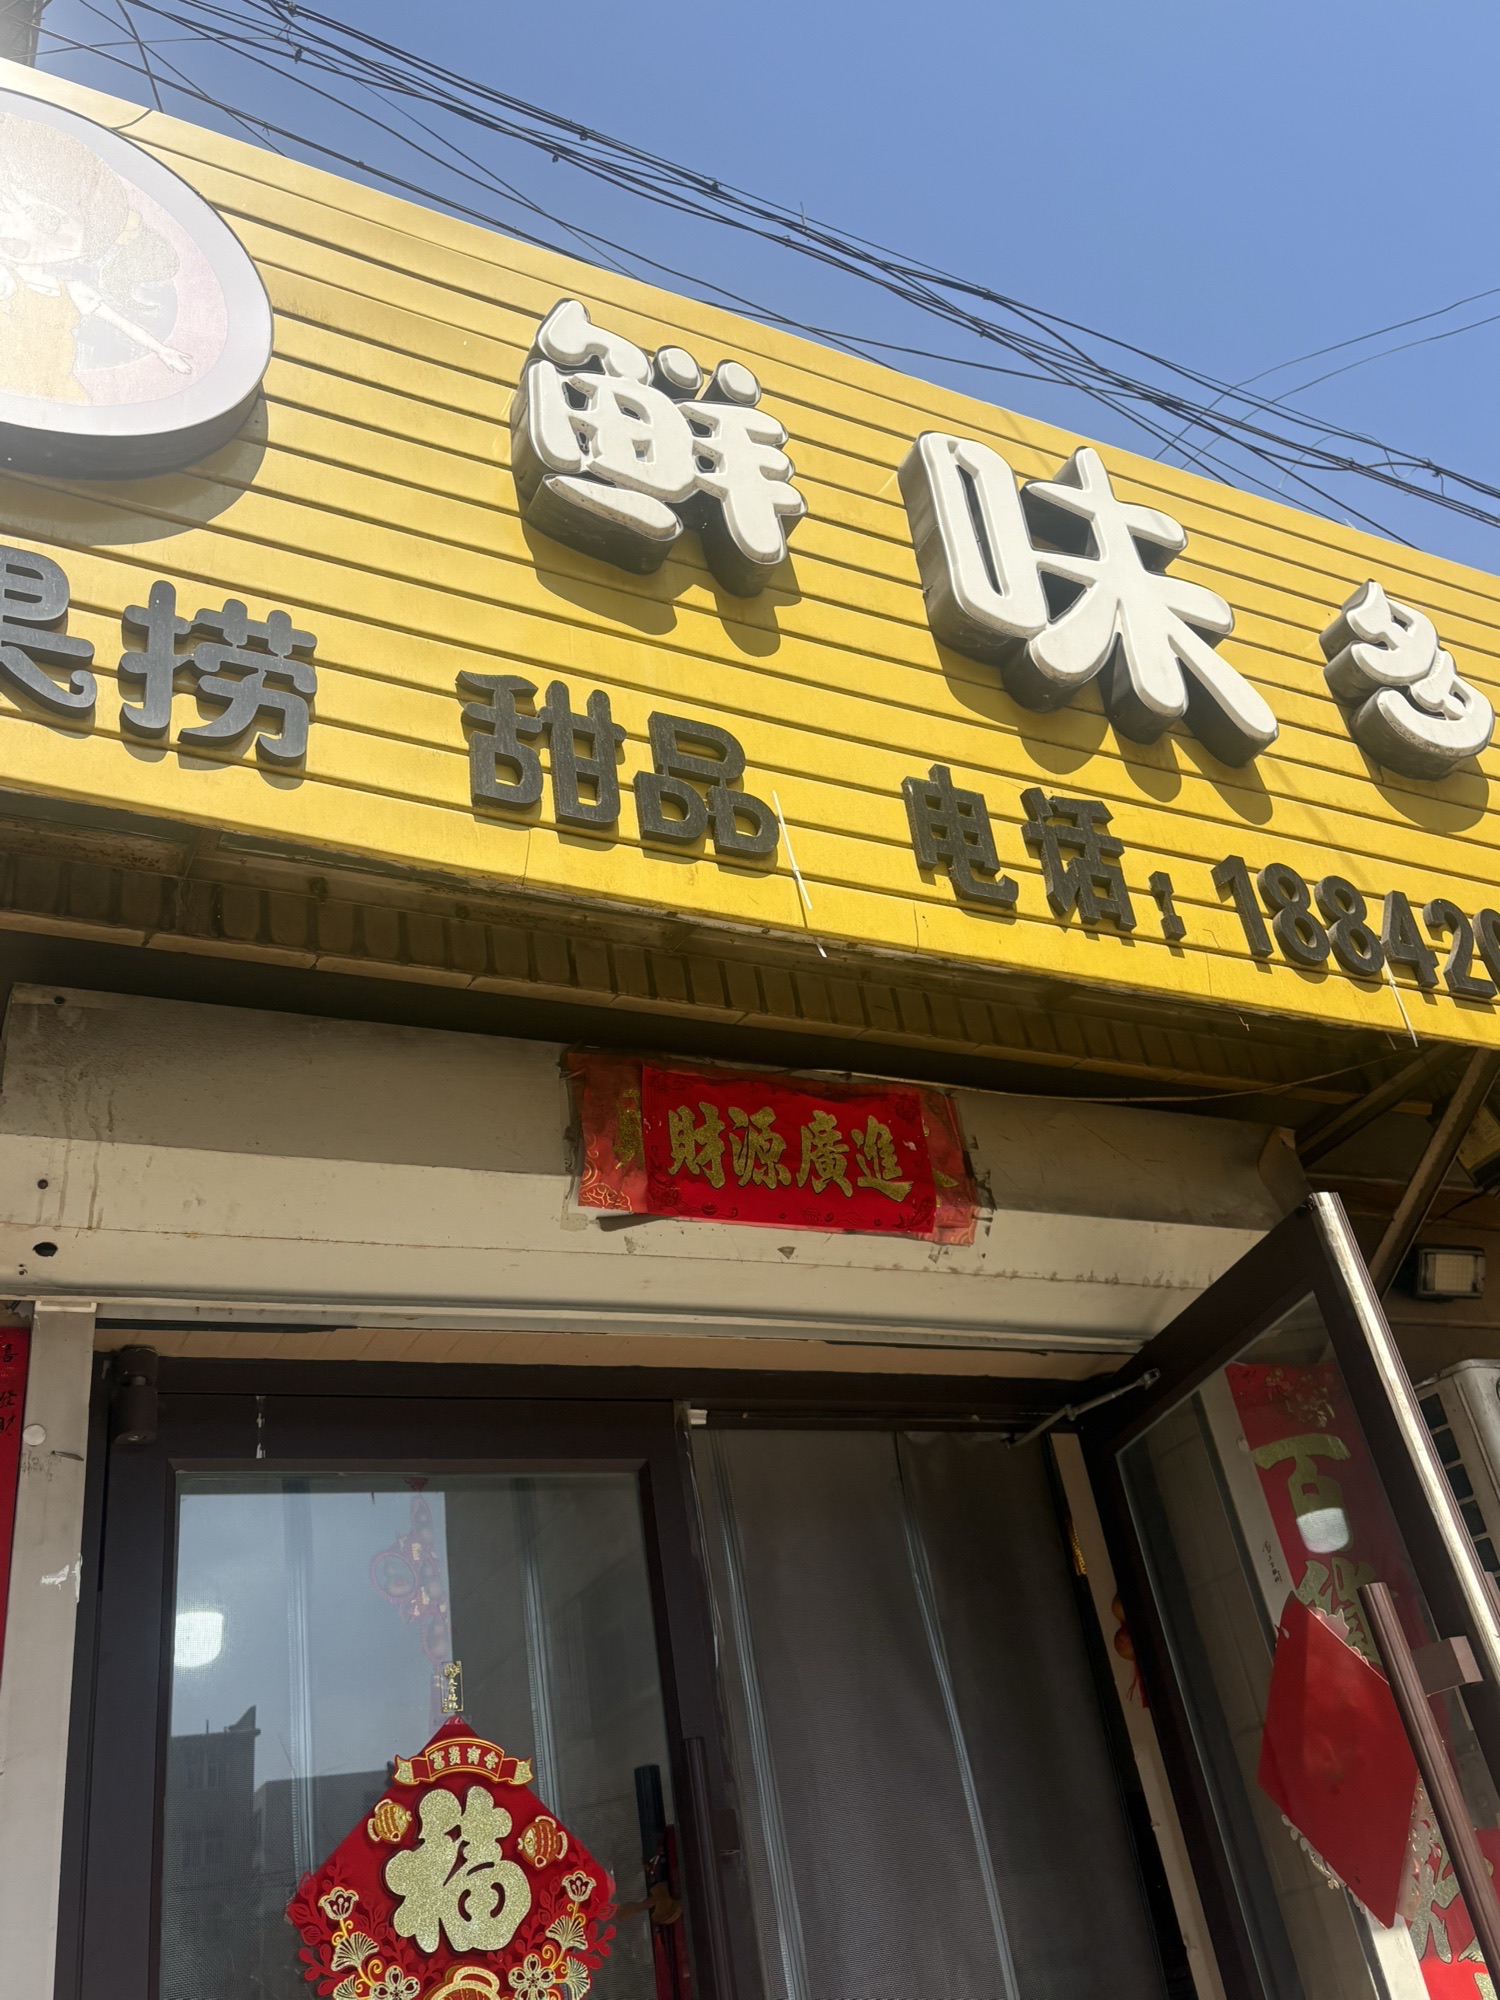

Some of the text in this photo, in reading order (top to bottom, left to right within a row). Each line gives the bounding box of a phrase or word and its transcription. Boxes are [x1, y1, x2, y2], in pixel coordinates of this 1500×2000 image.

[513, 298, 1496, 770] 鲜味多
[456, 670, 779, 857] 甜品
[385, 1785, 532, 1954] 福
